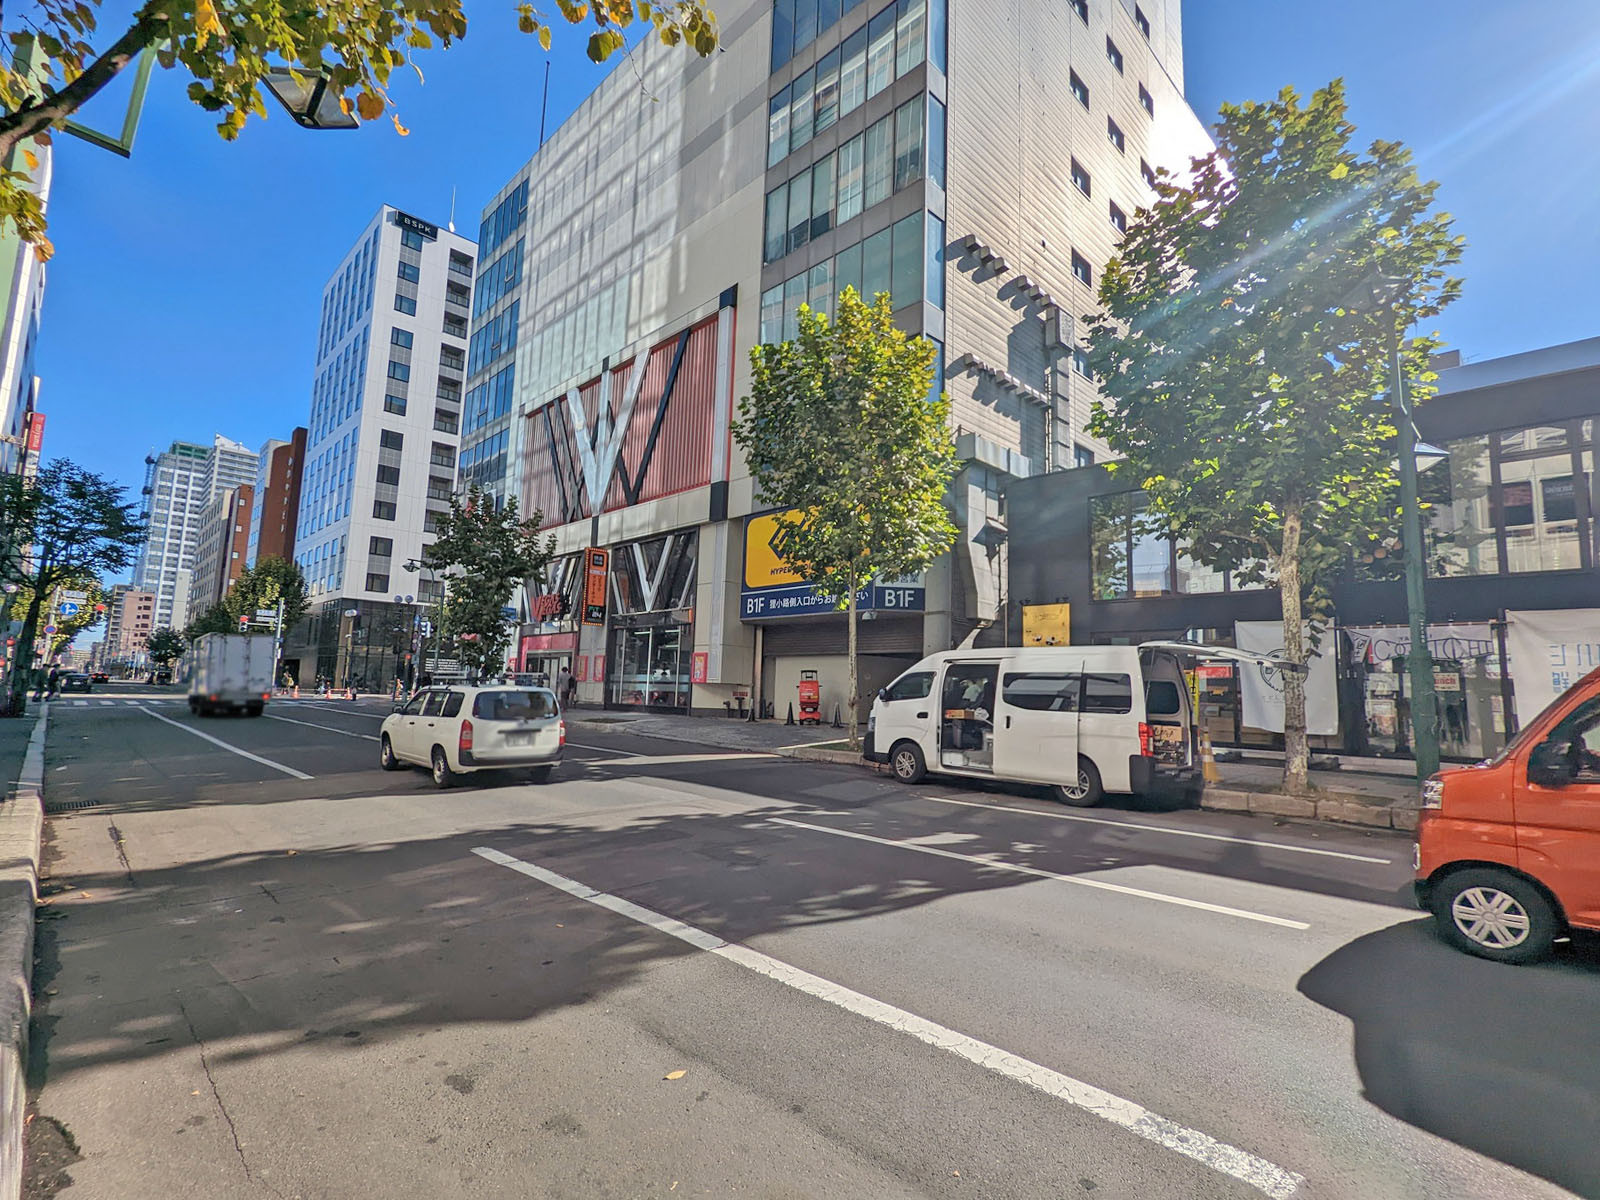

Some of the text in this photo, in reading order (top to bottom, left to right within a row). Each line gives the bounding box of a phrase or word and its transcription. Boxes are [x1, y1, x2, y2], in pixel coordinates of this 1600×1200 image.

[404, 217, 431, 233] BSPK
[746, 597, 765, 614] B1F
[885, 589, 915, 607] B1F
